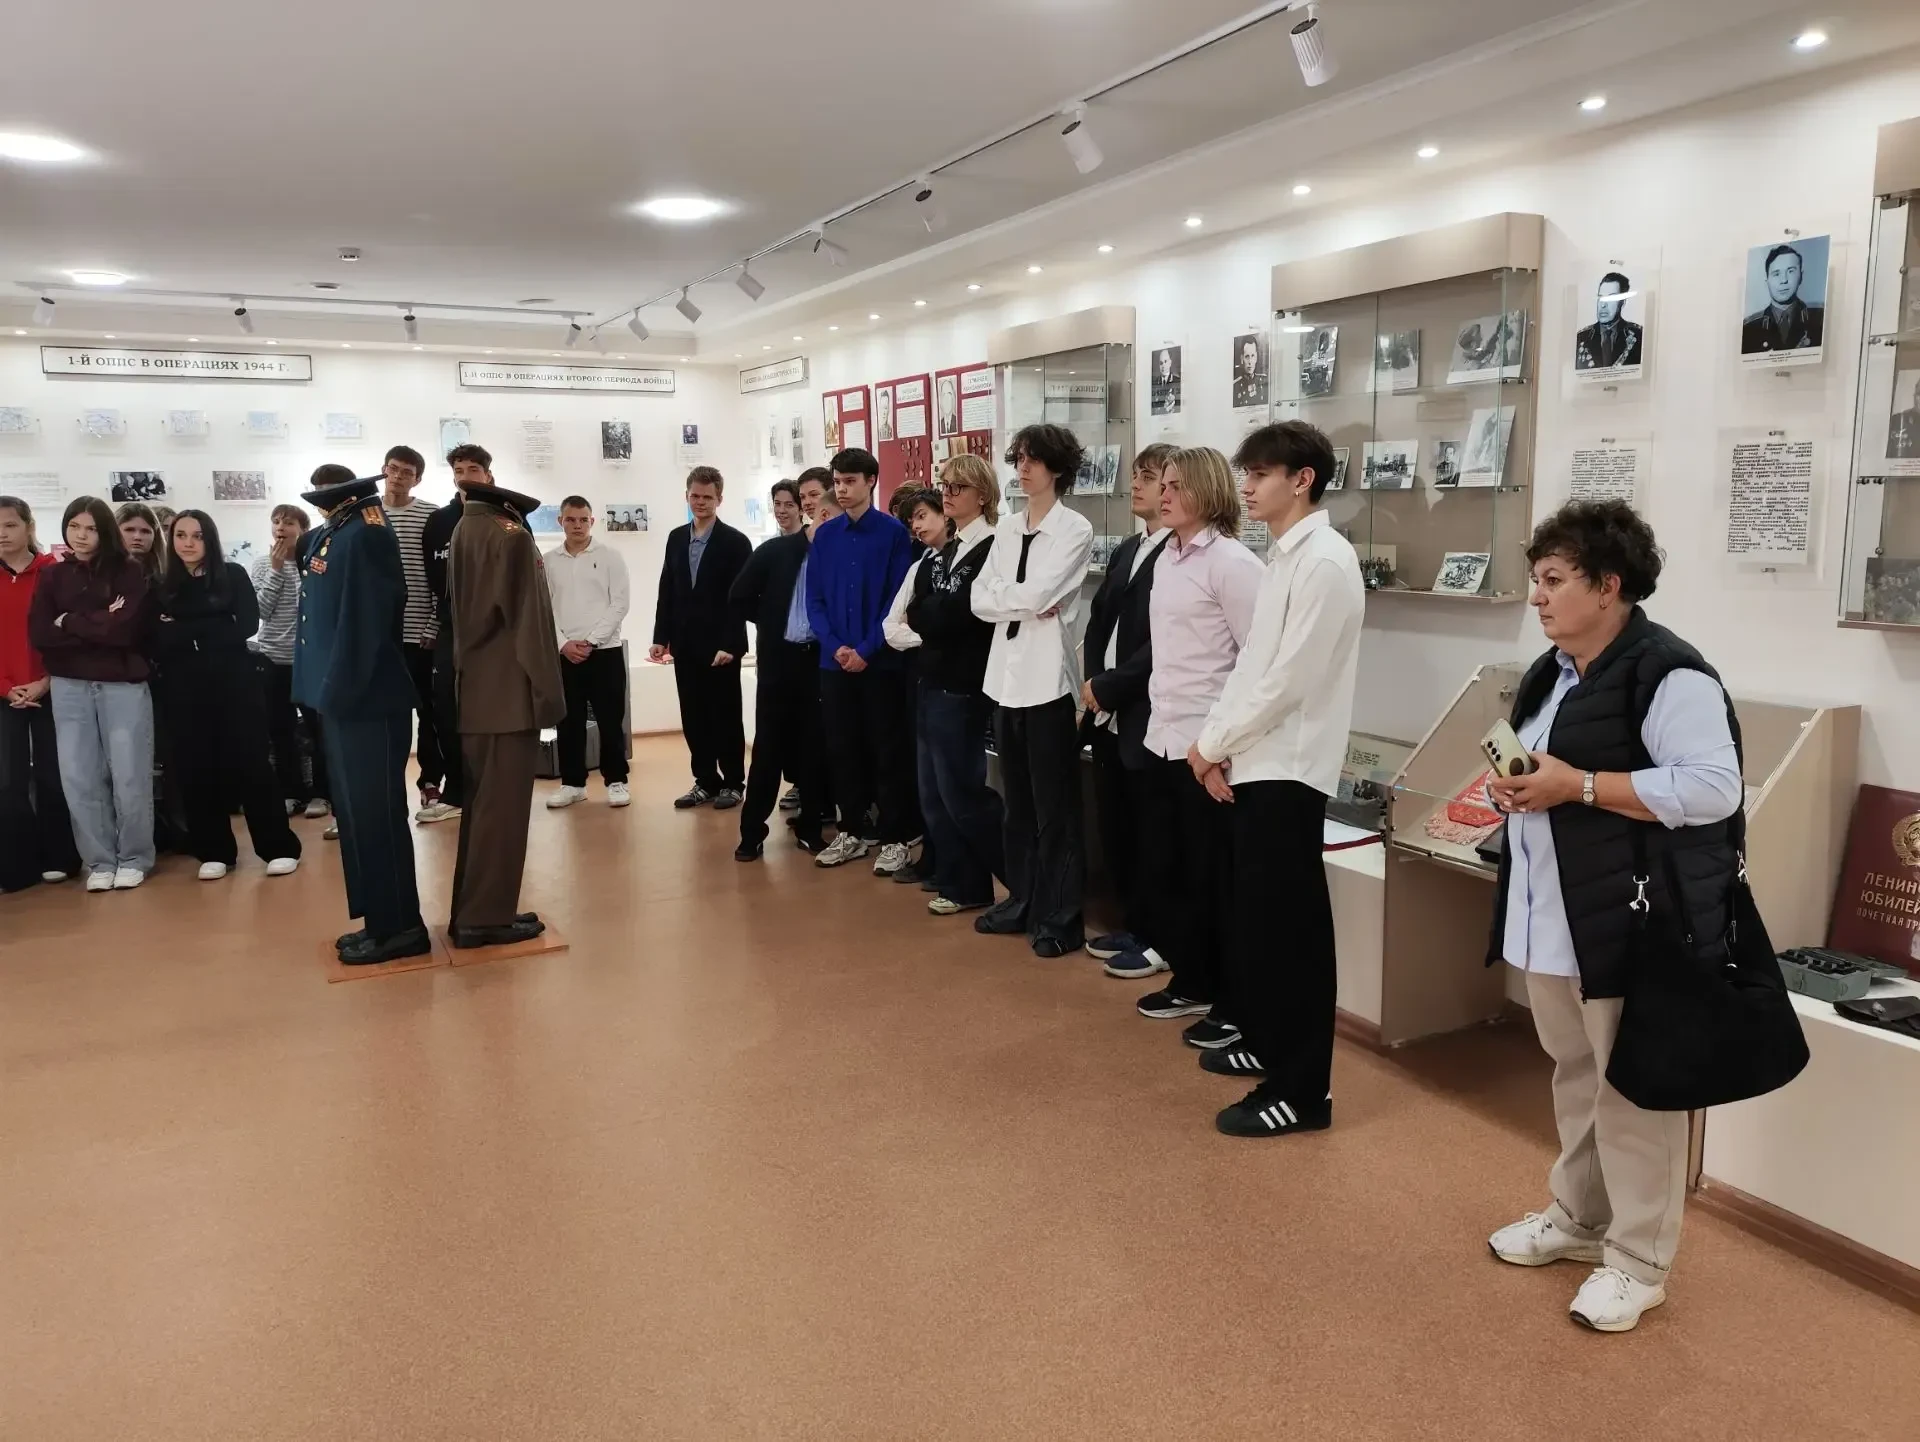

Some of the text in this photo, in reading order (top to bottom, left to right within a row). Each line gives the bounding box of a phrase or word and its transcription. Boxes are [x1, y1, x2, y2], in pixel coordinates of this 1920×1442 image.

[67, 353, 290, 372] 1-Й ОППС В ОПЕРАЦИЯХ 1944 Г.
[513, 372, 564, 382] ОПЕРАЦИЯХ
[566, 374, 603, 383] ВТОРОГО
[604, 376, 642, 385] ПЕРИОДА
[643, 376, 672, 385] ВОЙНЫ
[1864, 872, 1920, 895] ЛЕНИН
[1856, 907, 1920, 932] ПОЧЕТНАЯ ГР
